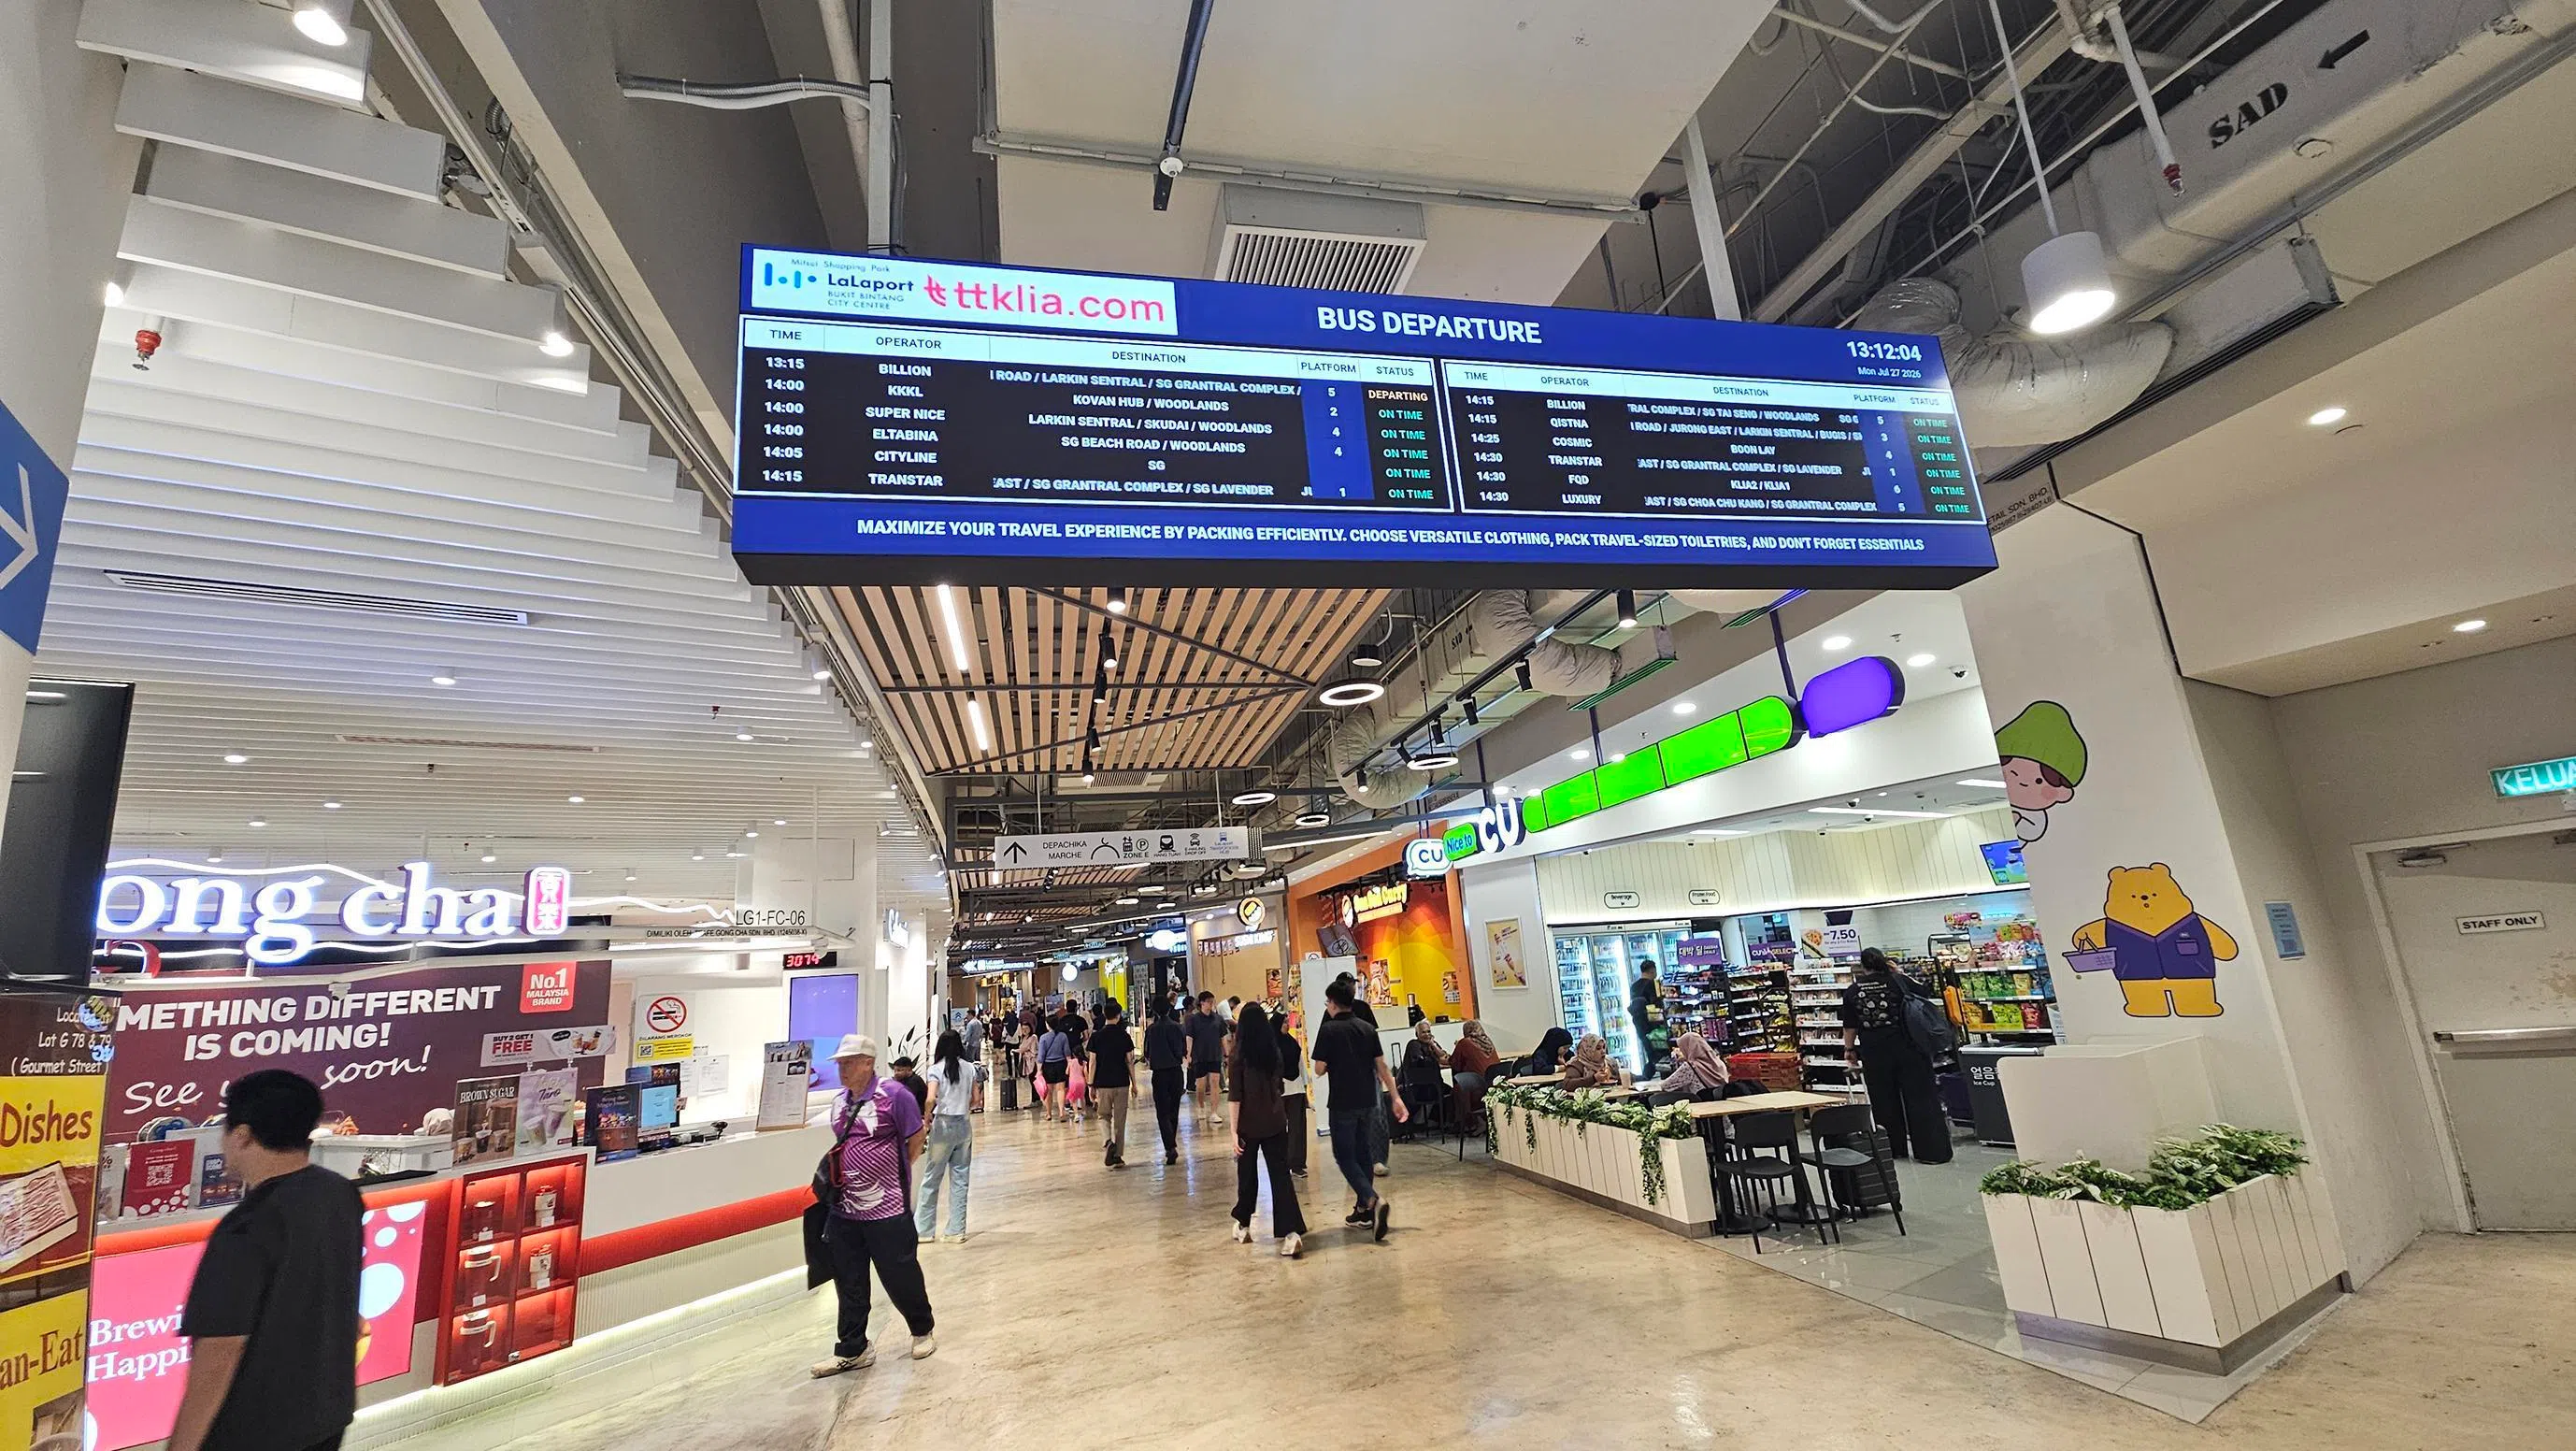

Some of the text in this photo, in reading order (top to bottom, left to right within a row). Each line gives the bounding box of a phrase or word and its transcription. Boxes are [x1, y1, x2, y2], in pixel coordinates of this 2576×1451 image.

[2209, 82, 2288, 150] SAD
[824, 261, 866, 272] Shopping
[828, 274, 914, 292] LaLaport
[828, 291, 904, 302] BUKIT BINTANG
[953, 281, 1165, 322] ttklia.com
[827, 299, 890, 309] CITY CENTRE
[1317, 306, 1542, 344] BUS DEPARTURE
[770, 329, 802, 340] TIME
[876, 337, 941, 349] OPERATOR
[1112, 352, 1186, 364] DESTINATION
[1846, 341, 1923, 362] 13:12:04
[766, 357, 805, 369] 13:15
[1301, 362, 1356, 373] PLATFORM
[879, 363, 931, 377] BILLION
[1376, 366, 1414, 376] STATUS
[1465, 371, 1488, 381] TIME
[1858, 366, 1922, 378] Mon Jul 27 2026
[765, 379, 805, 392] 14:00
[995, 370, 1295, 395] ROAD LARKIN SENTRAL SG GRANTRAL COMPLEX
[1540, 376, 1590, 387] OPERATOR
[888, 385, 923, 398] KKKL
[1368, 389, 1429, 401] DEPARTING
[1712, 386, 1769, 397] DESTINATION
[1073, 395, 1229, 411] KOVAN HUB WOODLANDS
[1466, 395, 1495, 406] 14:15
[1546, 399, 1586, 410] BILLION
[1853, 395, 1896, 403] PLATFORM
[1911, 396, 1939, 406] STATUS
[765, 402, 804, 414] 14:00
[866, 407, 946, 421] SUPER NICE
[1378, 409, 1424, 420] ON TIME
[1028, 414, 1273, 434] LARKIN SENTRAL SKUDAI WOODLANDS
[1467, 413, 1496, 424] 14:15
[1550, 418, 1589, 429] QISTNA
[764, 424, 804, 437] 14:00
[873, 428, 938, 442] ELTABINA
[1061, 437, 1246, 453] SG BEACH ROAD WOODLANDS
[1471, 433, 1500, 444] 14:25
[1552, 437, 1593, 448] COSMIC
[763, 446, 804, 459] 14:05
[1731, 444, 1776, 454] BOON LAY
[875, 451, 937, 464] CITYLINE
[1473, 453, 1503, 463] 14:30
[1548, 454, 1603, 467] TRANSTAR
[1148, 460, 1166, 470] SG
[763, 469, 803, 482] 14:15
[867, 473, 943, 487] TRANSTAR
[1476, 471, 1506, 482] 14:30
[1568, 475, 1590, 485] FQD
[1032, 479, 1274, 496] SG GRANTRAL COMPLEX SG LAVENDER
[1731, 480, 1791, 491] KLIA2 KLIA1
[1479, 491, 1509, 502] 14:30
[1561, 494, 1602, 505] LUXURY
[857, 519, 1925, 552] MAXIMIZE YOUR TRAVEL EXPERIENCE BY PACKING EFFICIENTLY. CHOOSE VERSATILE CLOTHING, PACK TRAVEL-SIZED TOILETRIES, AND DON'T FORGET ESSENTIALS
[2495, 760, 2576, 796] KELUA
[1479, 797, 1520, 854] CU
[1043, 840, 1087, 850] DEPACHIKA
[1447, 833, 1473, 853] Nice to
[1049, 852, 1082, 860] MARCHE
[1419, 849, 1443, 863] CU
[95, 862, 519, 963] ong cha
[736, 910, 806, 926] LG1-FC-06
[2462, 916, 2538, 929] STAFF ONLY
[1830, 929, 1856, 941] 7.50
[530, 968, 567, 990] No.1
[526, 989, 569, 998] MALAYSIA
[116, 985, 502, 1032] METHING DIFFERENT
[533, 997, 562, 1007] BRAND
[38, 1032, 57, 1048] Lot
[72, 1034, 85, 1048] 78
[183, 1022, 391, 1061] IS COMING!
[493, 1040, 533, 1055] FREE
[21, 1057, 103, 1073] Gourmet Street
[322, 1045, 431, 1091] soon!
[123, 1079, 204, 1113] See
[460, 1086, 515, 1104] BROWN SUGAR
[538, 1088, 561, 1101] Taro
[0, 1099, 93, 1149] Dishes
[89, 1305, 184, 1347] Brewi
[0, 1325, 83, 1390] an-Eat
[87, 1338, 193, 1385] Happi
